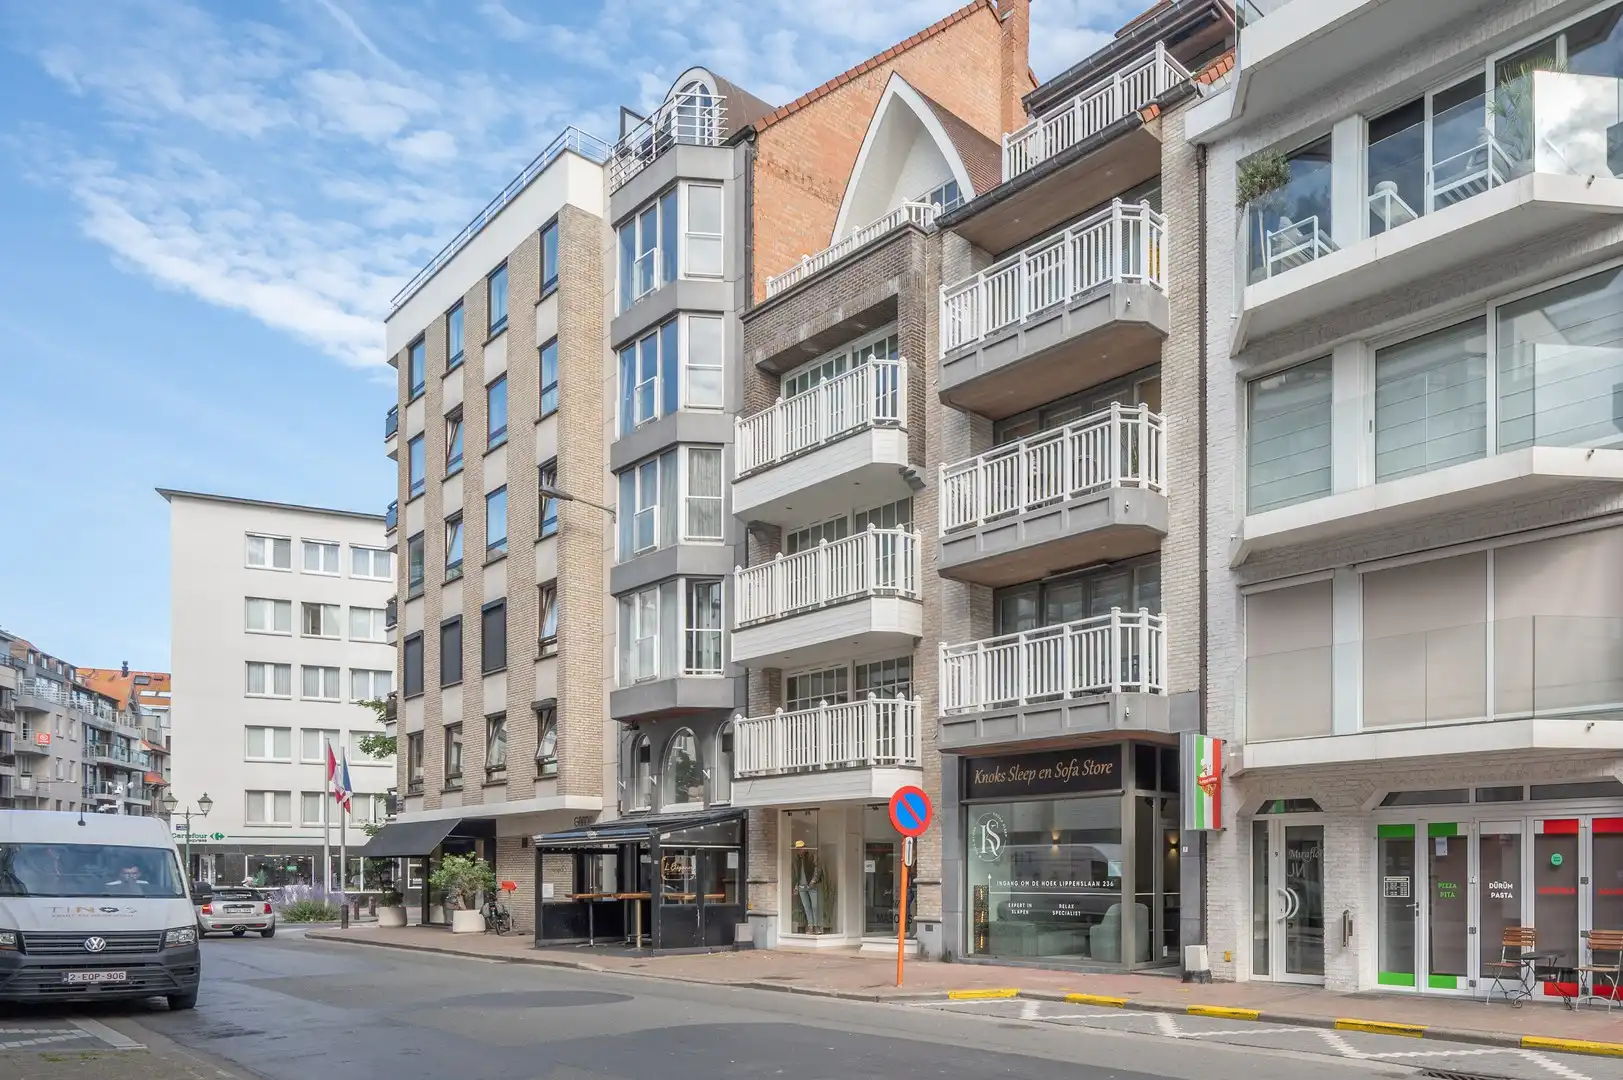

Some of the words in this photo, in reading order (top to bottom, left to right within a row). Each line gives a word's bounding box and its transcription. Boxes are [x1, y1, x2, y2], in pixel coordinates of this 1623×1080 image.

[974, 765, 1006, 784] Knoks
[1007, 763, 1036, 785] Sleep
[1038, 767, 1052, 779] en
[1054, 758, 1079, 783] Sofa
[1081, 759, 1113, 776] Store
